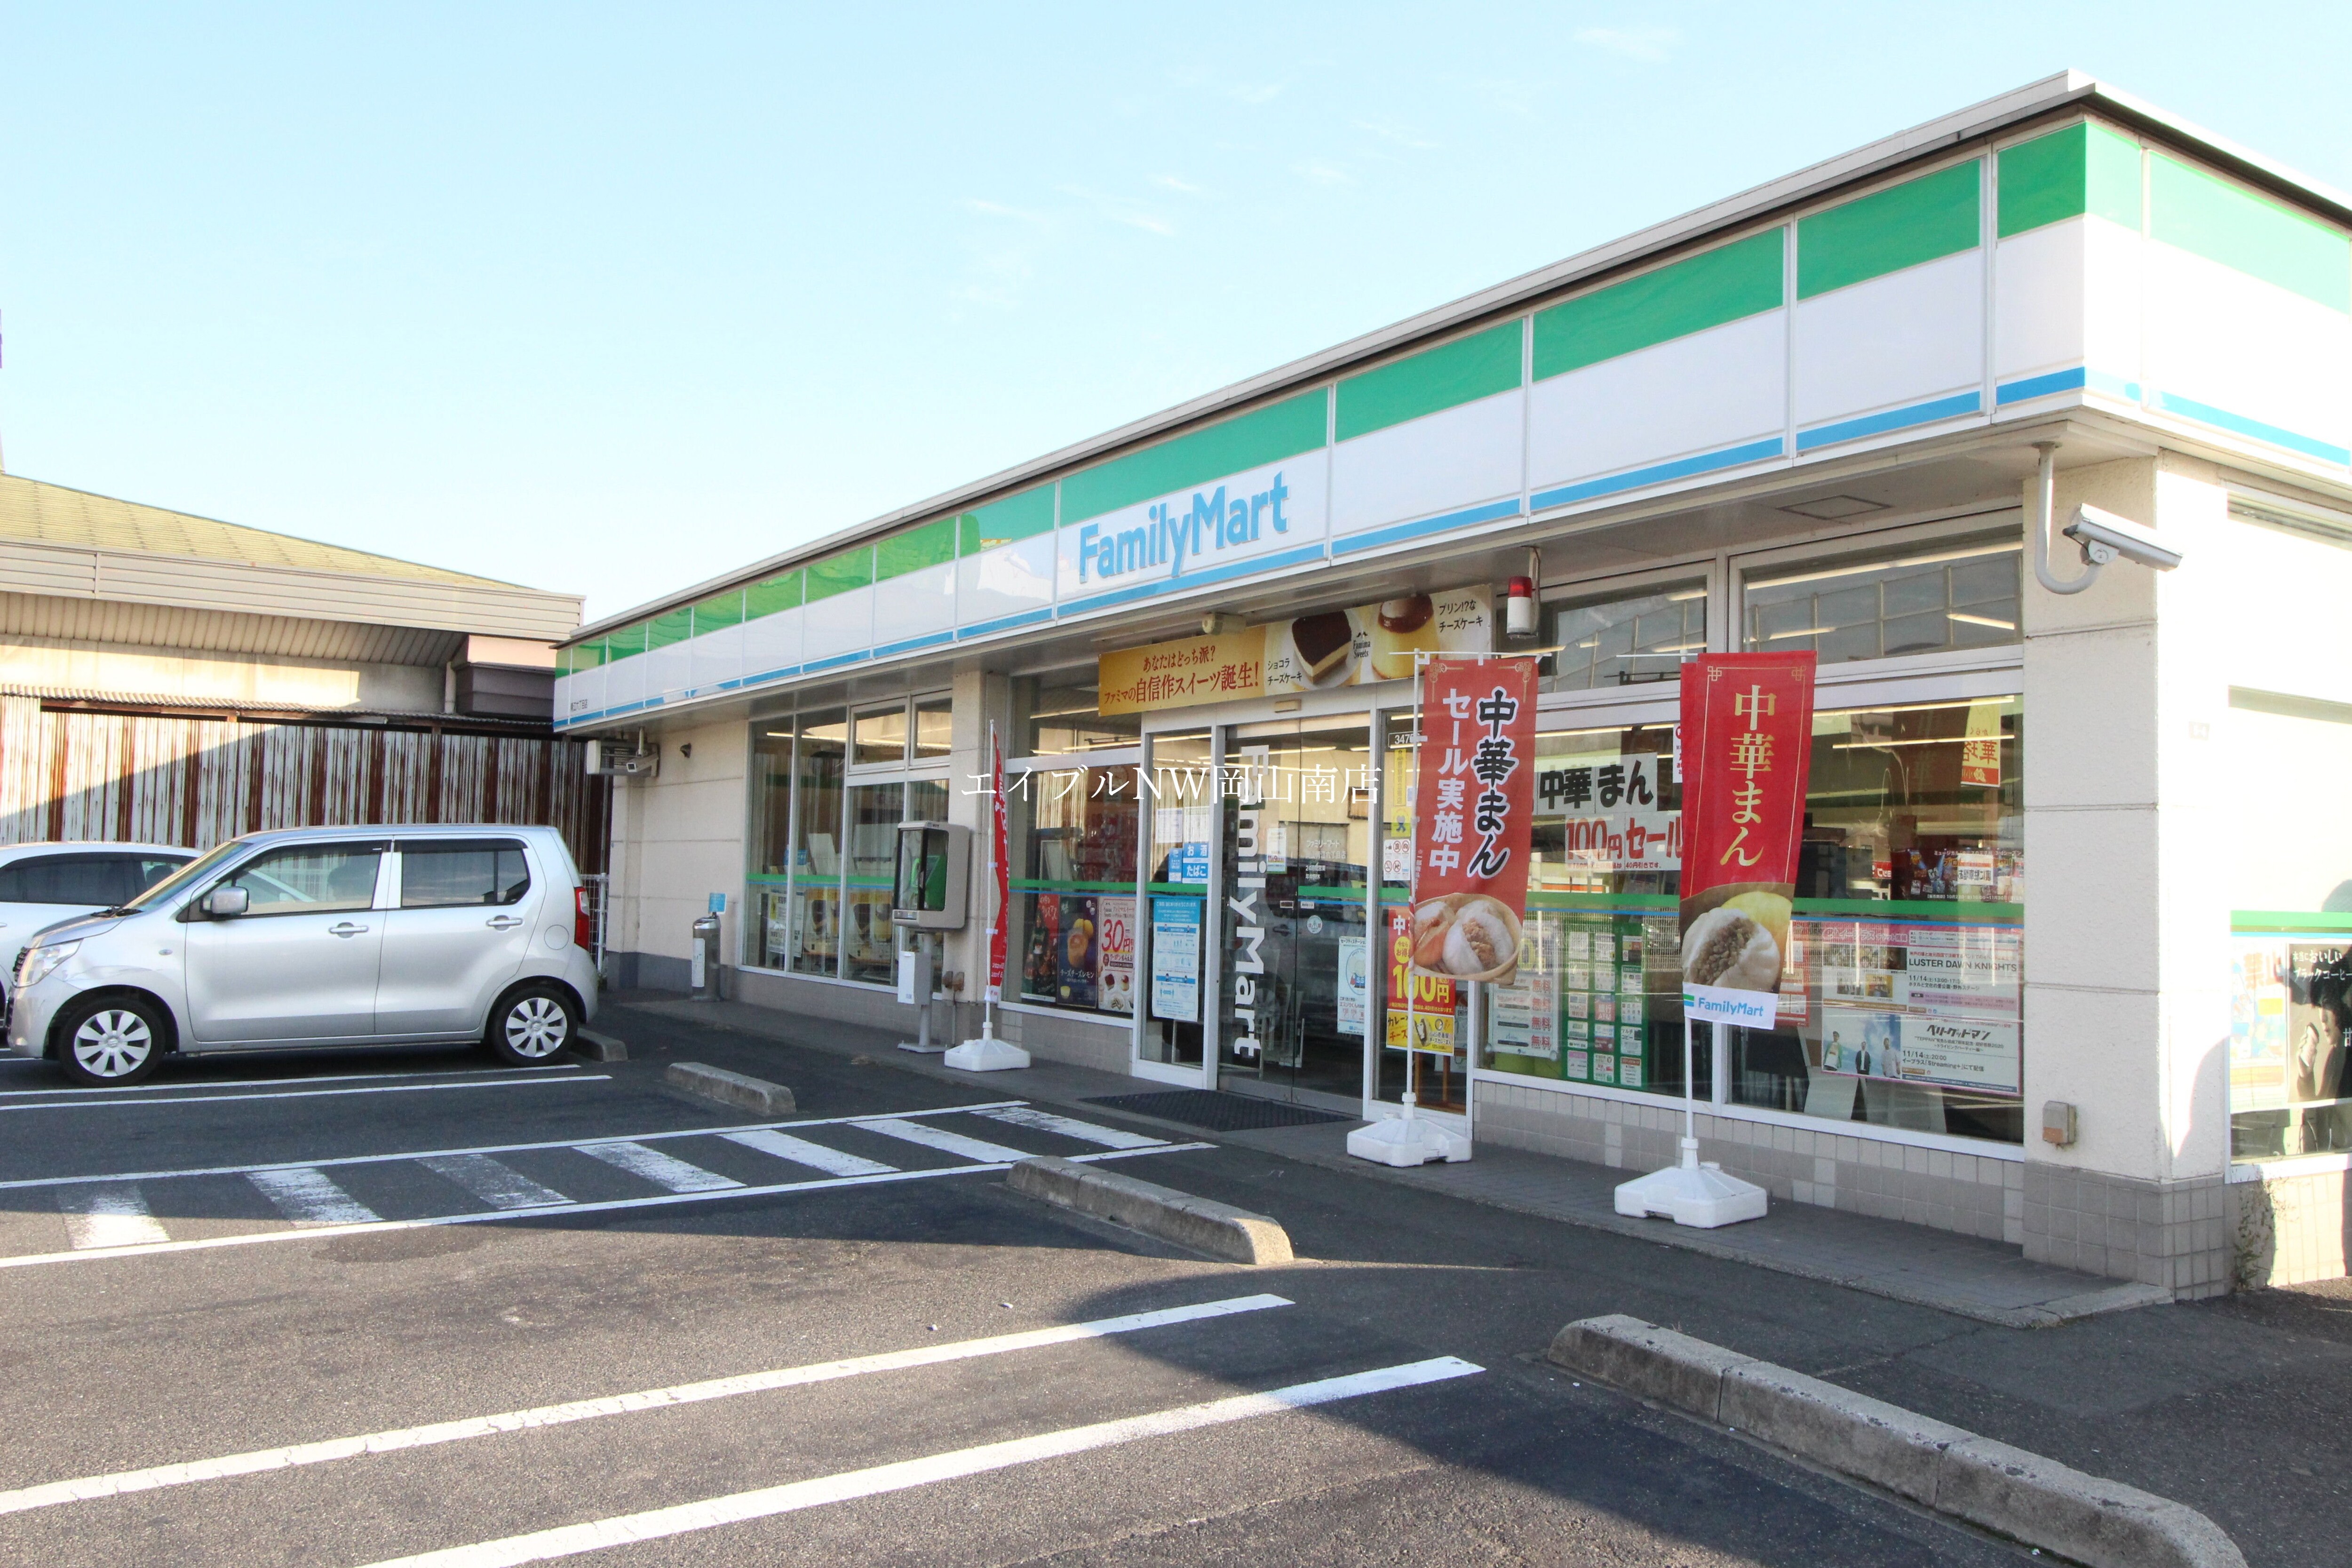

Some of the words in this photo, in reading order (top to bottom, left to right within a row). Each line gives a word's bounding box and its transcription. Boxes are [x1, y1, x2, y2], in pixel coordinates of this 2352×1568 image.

[1080, 471, 1288, 584] FamilyMart
[1438, 616, 1484, 633] チーズケーキ
[1144, 645, 1216, 673] あなたはどっち派?
[1267, 658, 1290, 671] ショコラ
[1104, 661, 1259, 704] ファミマの自信作スイーツ誕生!
[1267, 672, 1303, 686] チーズケーキ
[1429, 688, 1471, 876] セール実施中
[1468, 686, 1519, 879] 中華まん
[1539, 760, 1653, 810] 中華まん
[1719, 685, 1776, 867] 中華まん
[1186, 864, 1207, 877] たばこ
[1229, 745, 1269, 1058] FamilyMart
[1909, 958, 1943, 967] LUSTER
[1946, 960, 1971, 969] DAWN
[1975, 961, 2017, 972] KNIGHTS
[2292, 949, 2343, 964] 本当においしい
[1699, 997, 1764, 1017] FamilyMart
